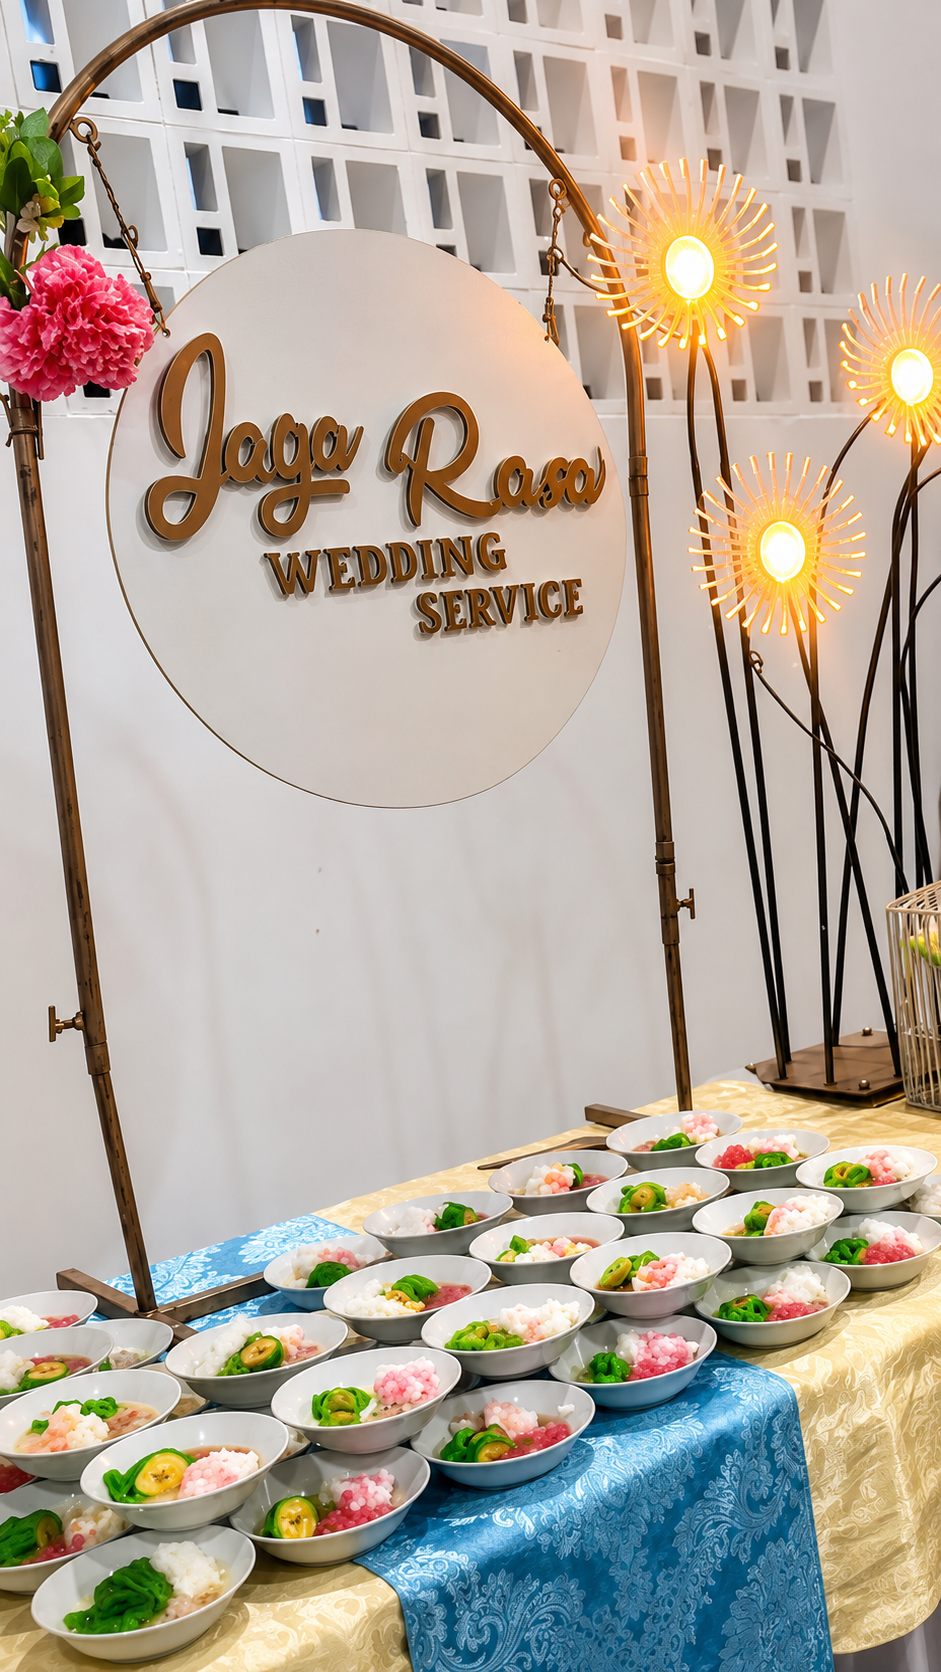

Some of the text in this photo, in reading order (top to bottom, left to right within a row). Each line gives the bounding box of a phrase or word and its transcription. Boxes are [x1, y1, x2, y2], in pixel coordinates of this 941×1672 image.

[145, 332, 606, 541] Jaga Rasa
[263, 532, 508, 595] WEDDING
[416, 578, 584, 634] SERVICE
